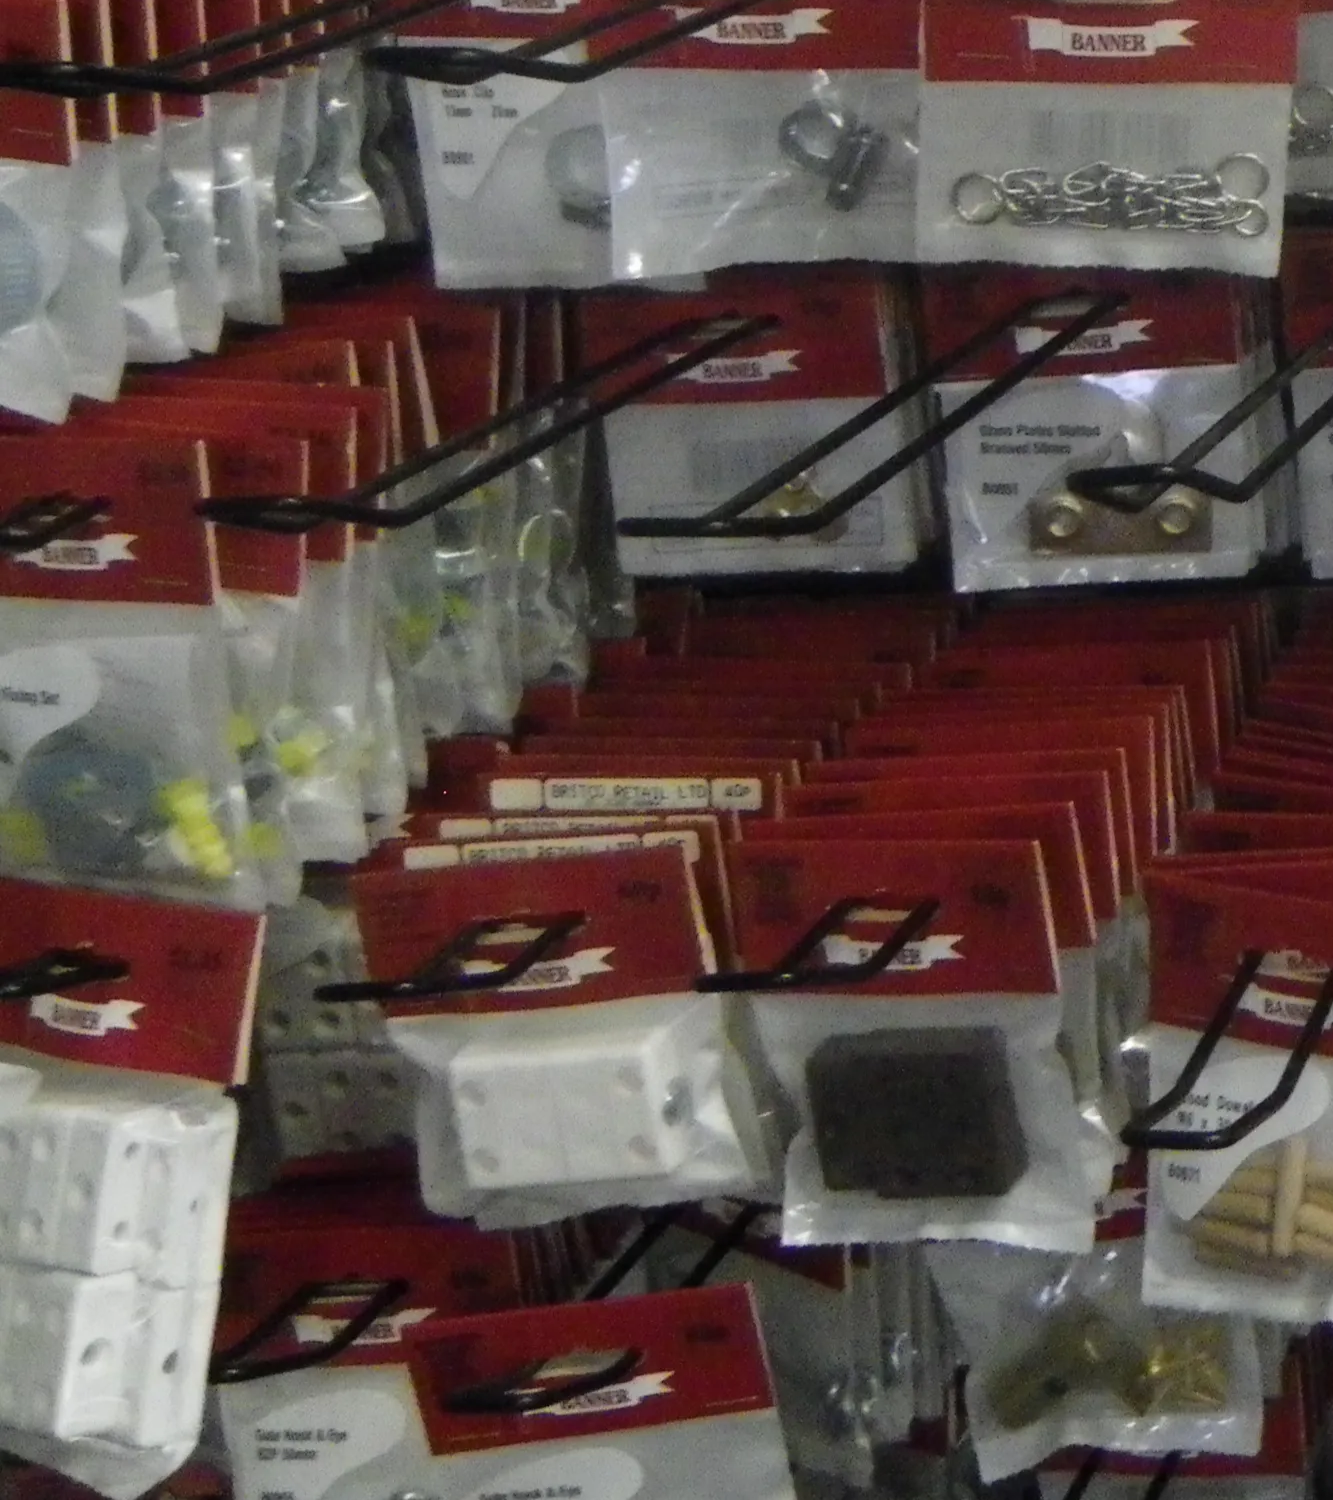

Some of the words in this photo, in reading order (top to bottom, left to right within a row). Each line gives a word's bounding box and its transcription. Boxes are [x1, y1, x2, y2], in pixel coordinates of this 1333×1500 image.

[716, 21, 787, 40] BANNER
[1071, 32, 1146, 52] BANNER
[702, 361, 762, 380] BANNER
